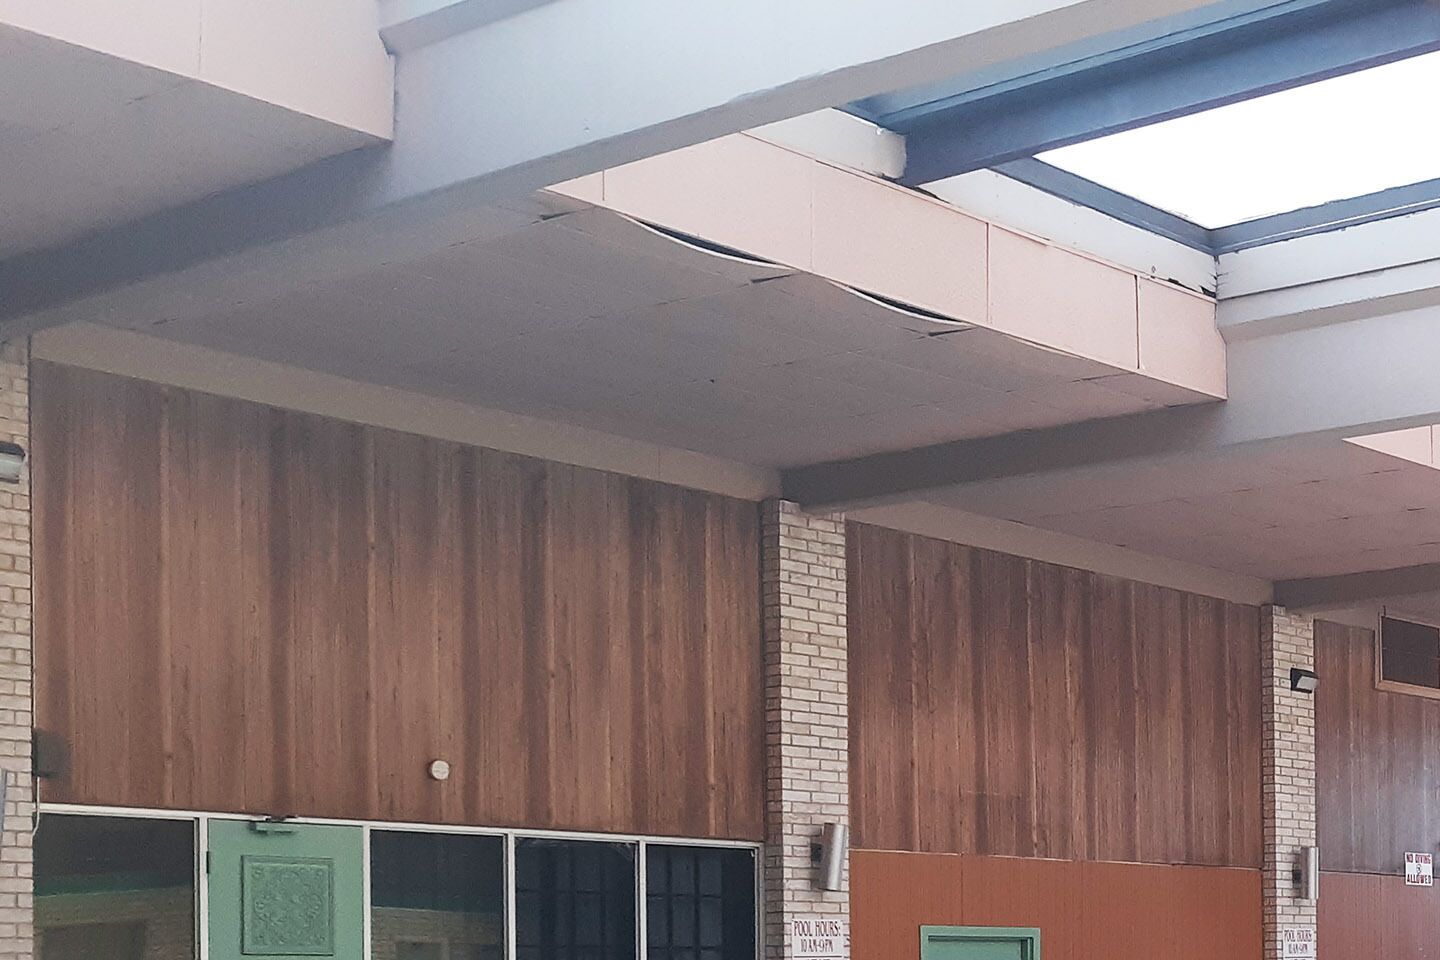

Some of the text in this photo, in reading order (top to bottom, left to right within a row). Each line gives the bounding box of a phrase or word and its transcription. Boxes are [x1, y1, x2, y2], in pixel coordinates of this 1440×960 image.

[1406, 853, 1414, 863] NO
[1406, 874, 1432, 884] ALLOWED
[793, 920, 812, 936] POOL
